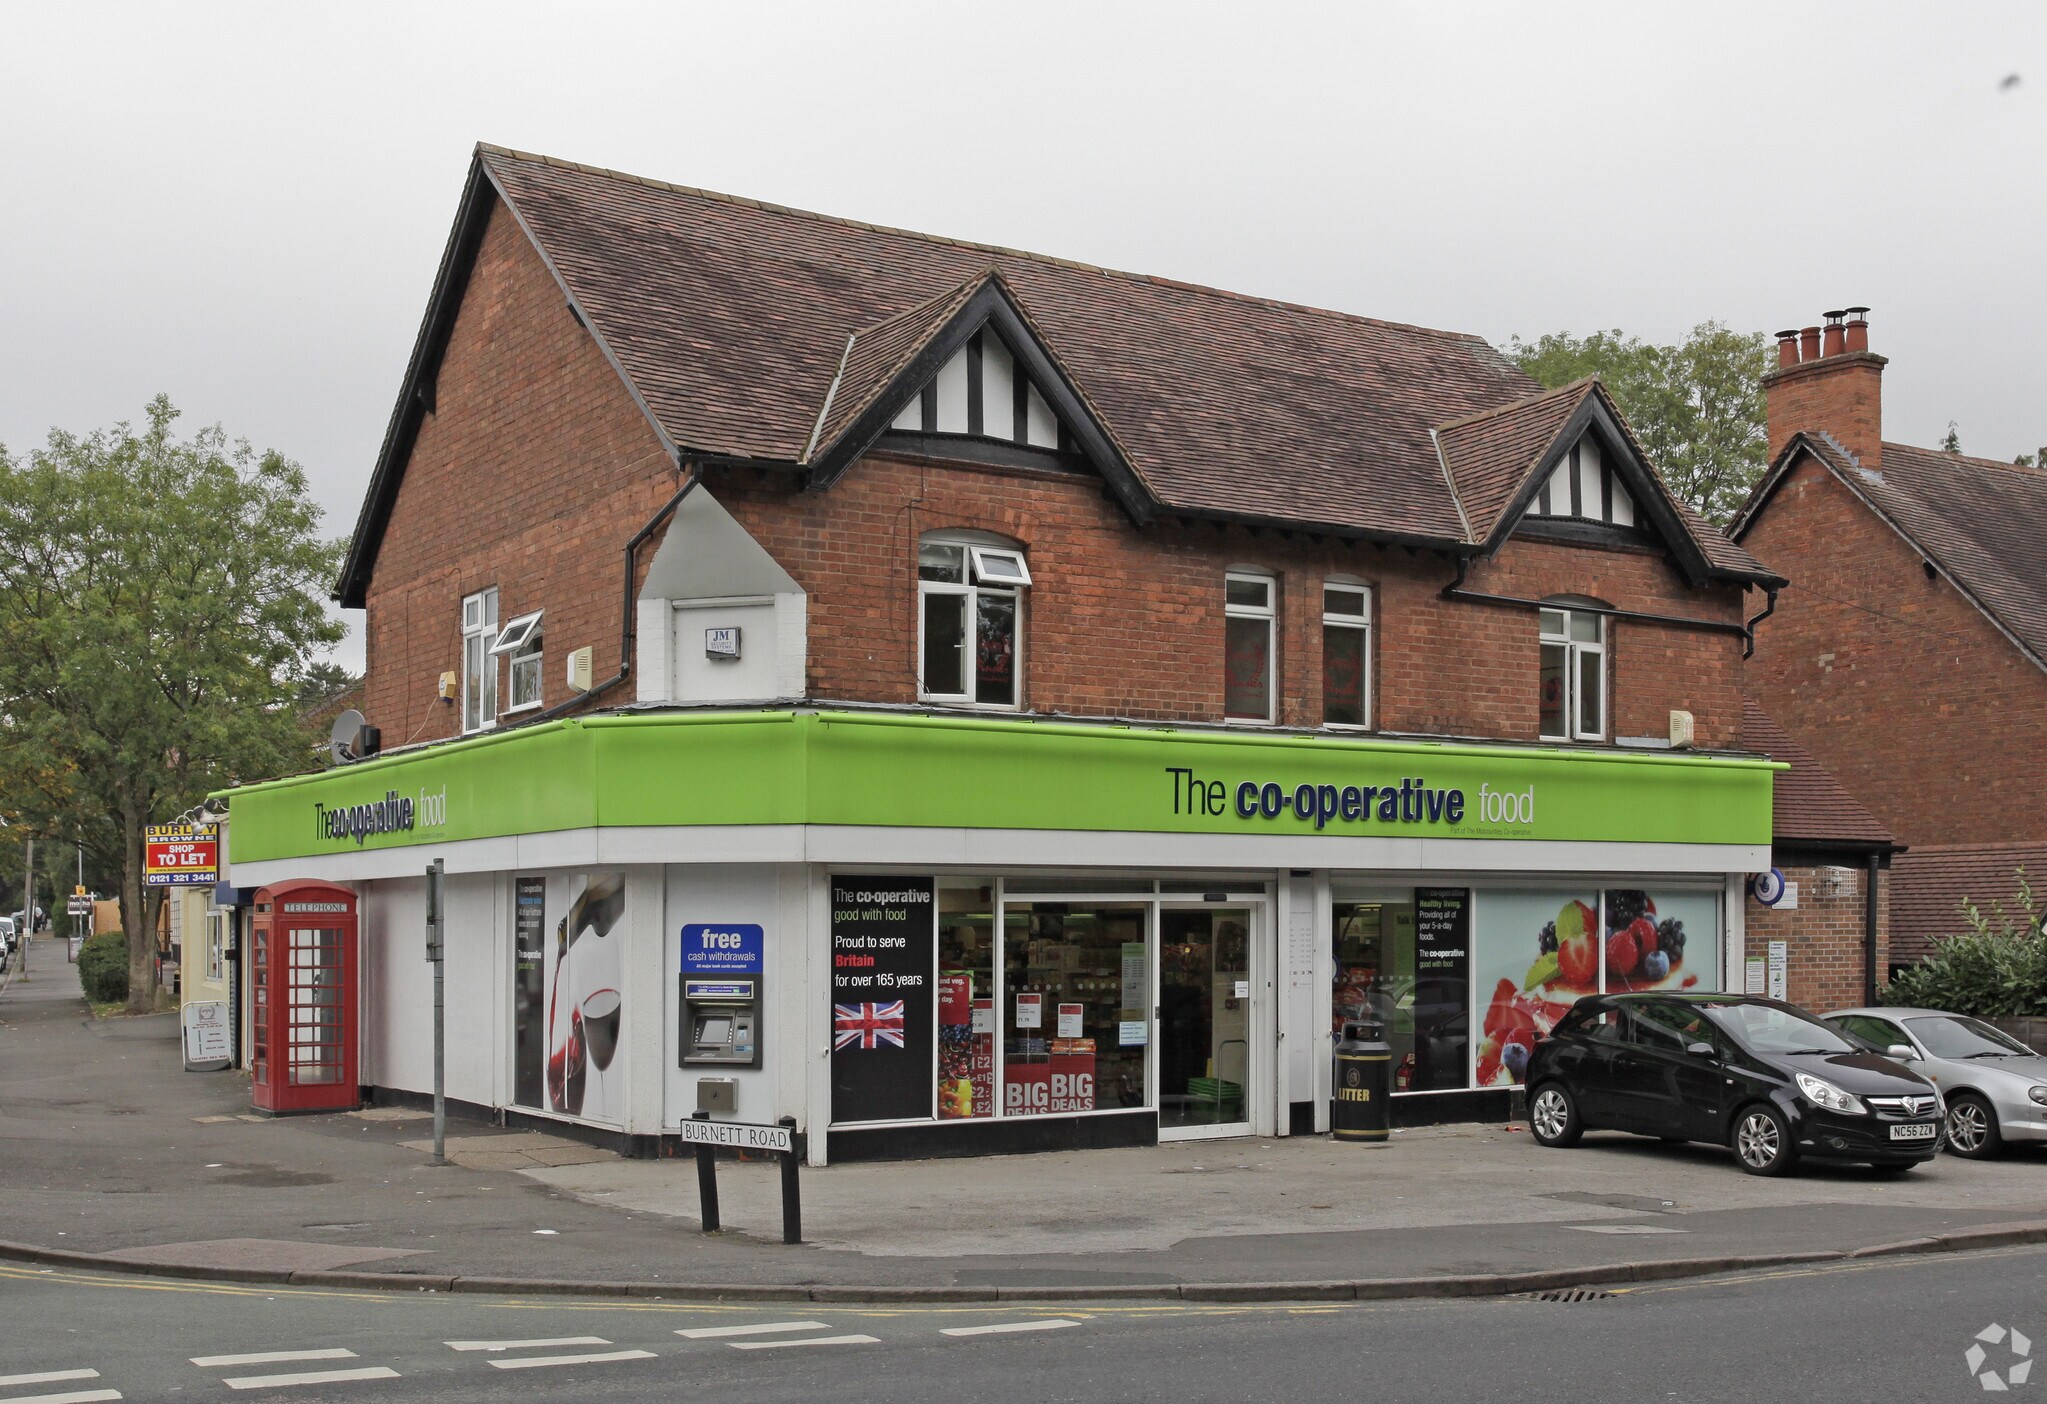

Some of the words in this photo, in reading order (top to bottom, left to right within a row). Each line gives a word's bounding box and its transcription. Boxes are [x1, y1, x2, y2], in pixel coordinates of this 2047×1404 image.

[713, 631, 729, 641] JM
[1166, 768, 1226, 816] The
[1235, 778, 1465, 830] co-operative
[1478, 782, 1534, 824] food
[315, 802, 332, 840] The
[332, 789, 414, 844] co-operative
[420, 784, 446, 827] food
[148, 824, 215, 835] BURLY
[158, 854, 176, 865] TO
[181, 853, 206, 865] LET
[835, 888, 854, 902] The
[856, 889, 930, 905] co-operative
[1444, 901, 1462, 909] living.
[834, 908, 859, 923] good
[862, 908, 882, 920] with
[885, 908, 907, 920] food
[1420, 911, 1443, 920] Providing
[1432, 922, 1452, 930] 5-a-day
[702, 929, 741, 949] free
[835, 936, 864, 948] Proud
[867, 936, 877, 948] to
[880, 938, 906, 948] serve
[688, 952, 706, 961] cash
[709, 952, 756, 961] withdrawals
[1430, 949, 1464, 958] co-operative
[835, 954, 874, 967] Britain
[1419, 961, 1431, 969] good
[835, 974, 849, 986] for
[851, 976, 872, 986] over
[876, 974, 894, 986] 165
[896, 975, 922, 988] years
[1051, 1073, 1093, 1098] BIG
[1007, 1082, 1048, 1106] BIG
[1339, 1088, 1370, 1101] LITTER
[1051, 1098, 1093, 1111] DEALS
[686, 1124, 742, 1143] BURNETT
[750, 1129, 786, 1147] ROAD
[1894, 1126, 1917, 1136] NC56
